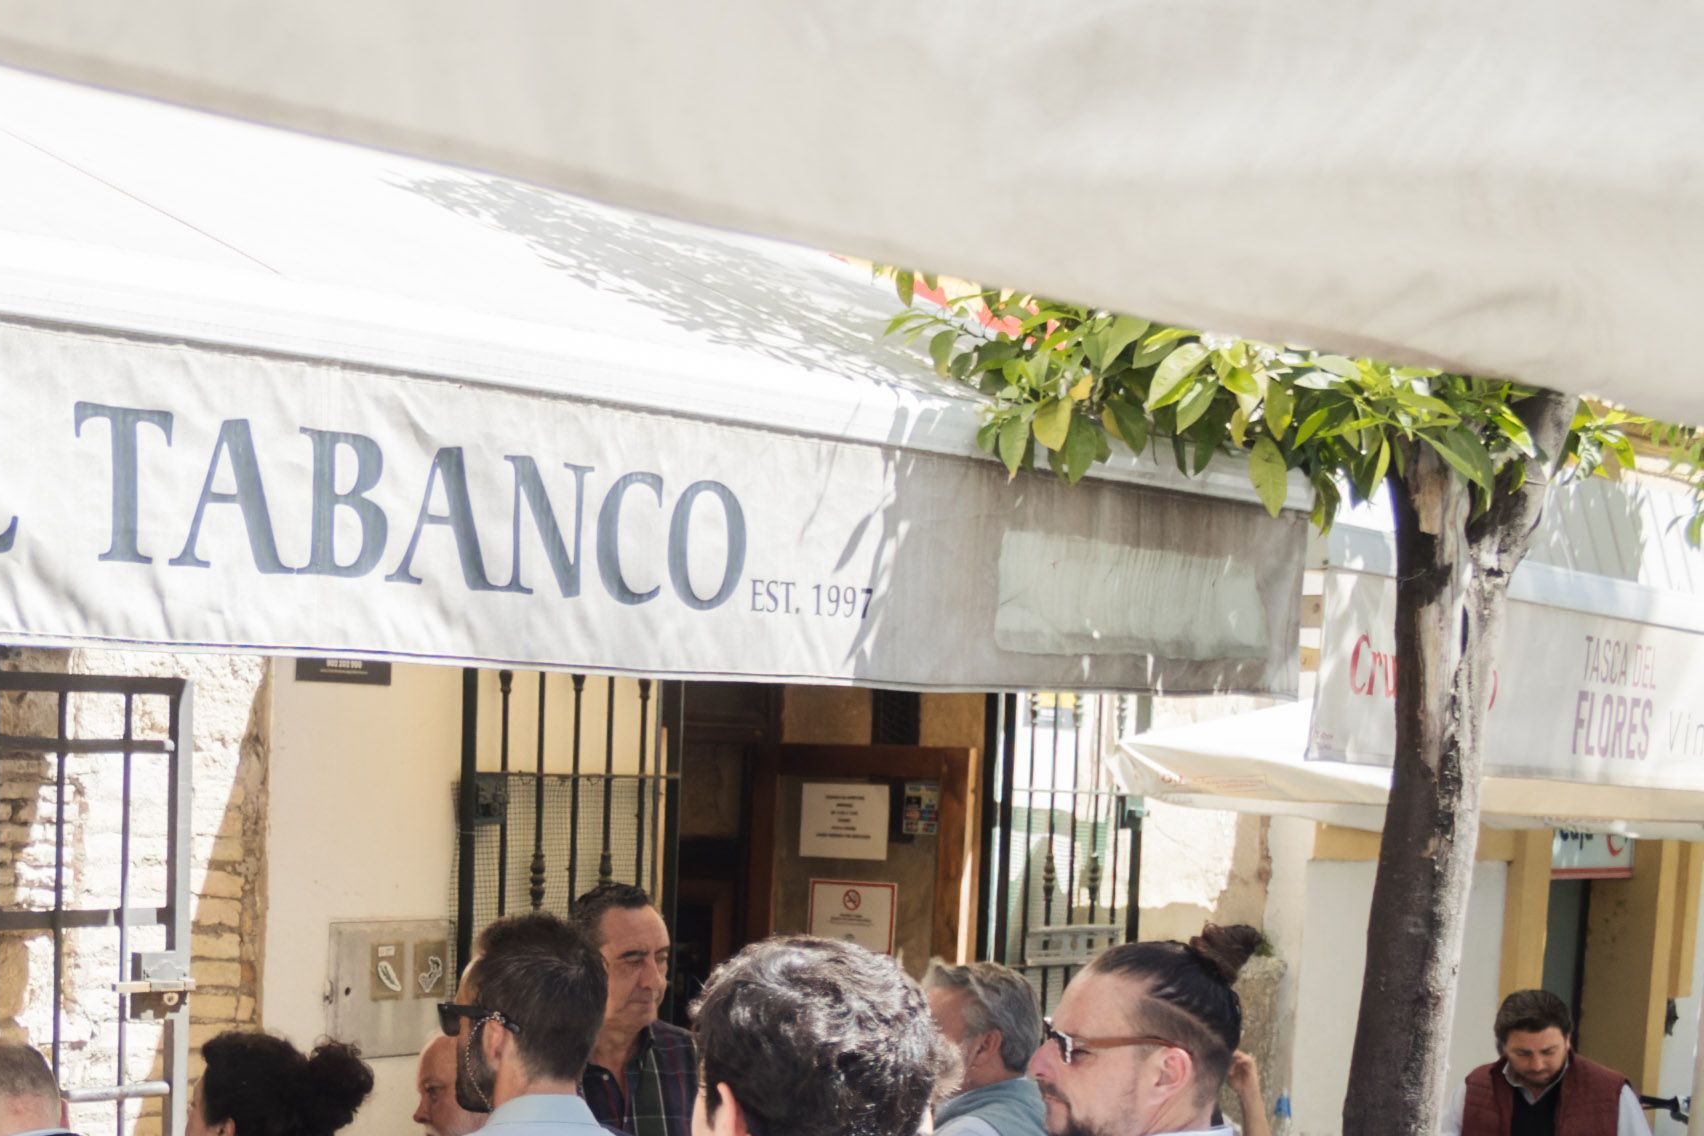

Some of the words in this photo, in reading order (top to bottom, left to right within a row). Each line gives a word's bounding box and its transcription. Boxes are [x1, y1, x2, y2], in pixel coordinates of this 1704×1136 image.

[74, 400, 747, 611] TABANCO
[750, 579, 800, 614] EST.
[812, 584, 873, 619] 1997
[1584, 635, 1628, 686] TASCA
[1632, 643, 1656, 690] DEL
[1572, 690, 1653, 761] FLORES
